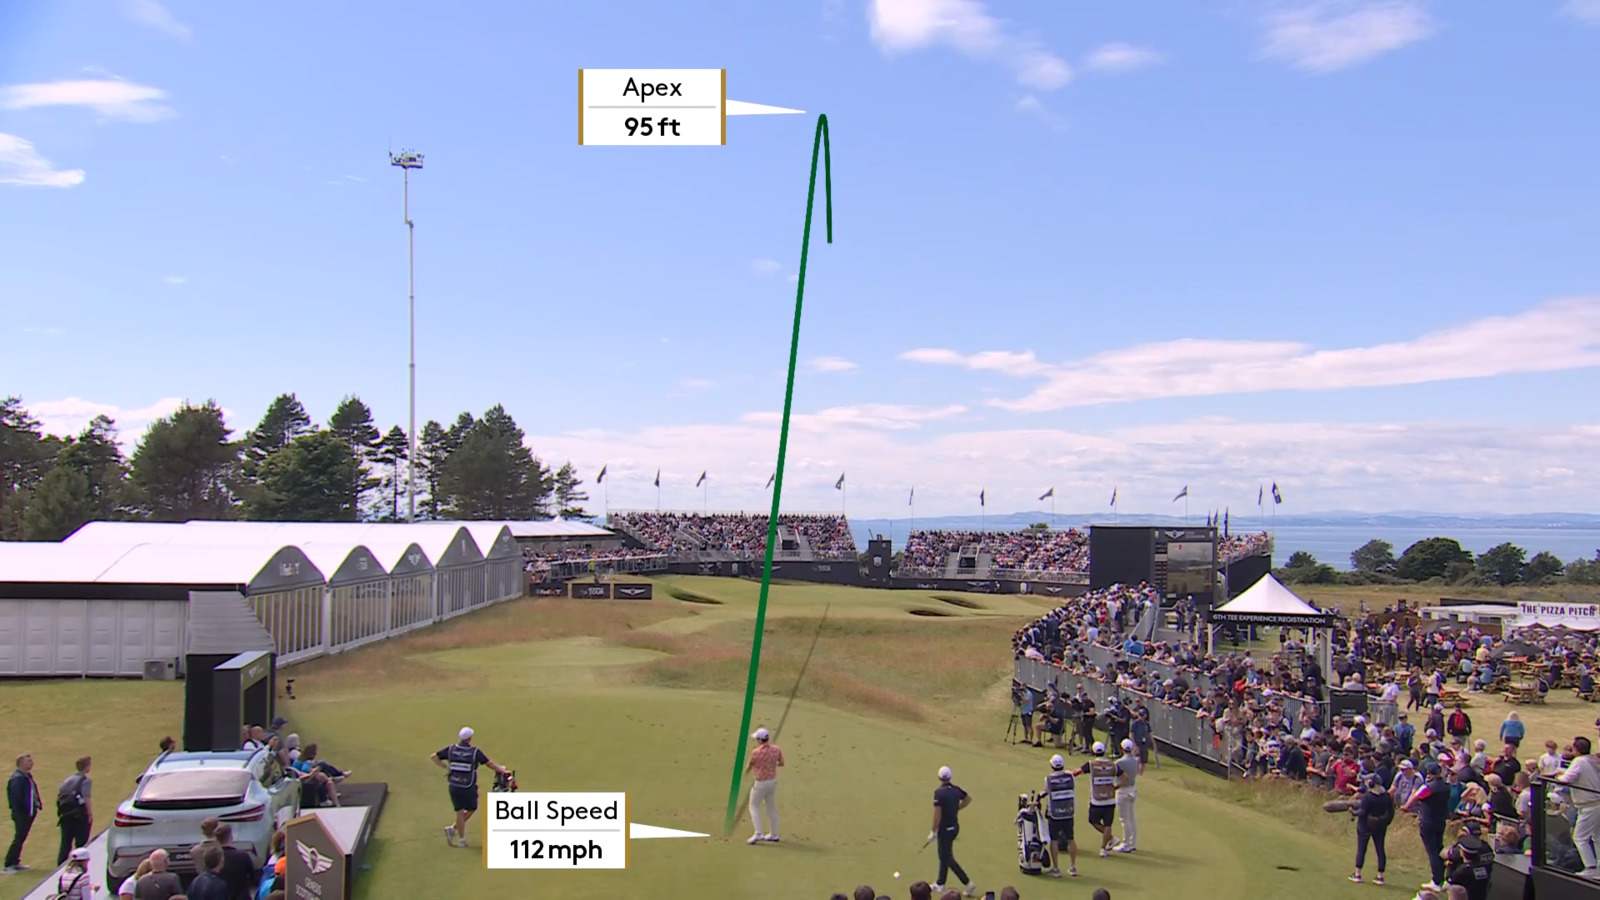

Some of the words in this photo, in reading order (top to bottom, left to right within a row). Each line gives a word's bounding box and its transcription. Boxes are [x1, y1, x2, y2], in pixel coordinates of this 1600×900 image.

[1521, 604, 1537, 614] THE
[1541, 605, 1565, 615] PIZZA
[1238, 614, 1276, 622] EXPERIENCE
[1278, 615, 1326, 624] REGISTRATION
